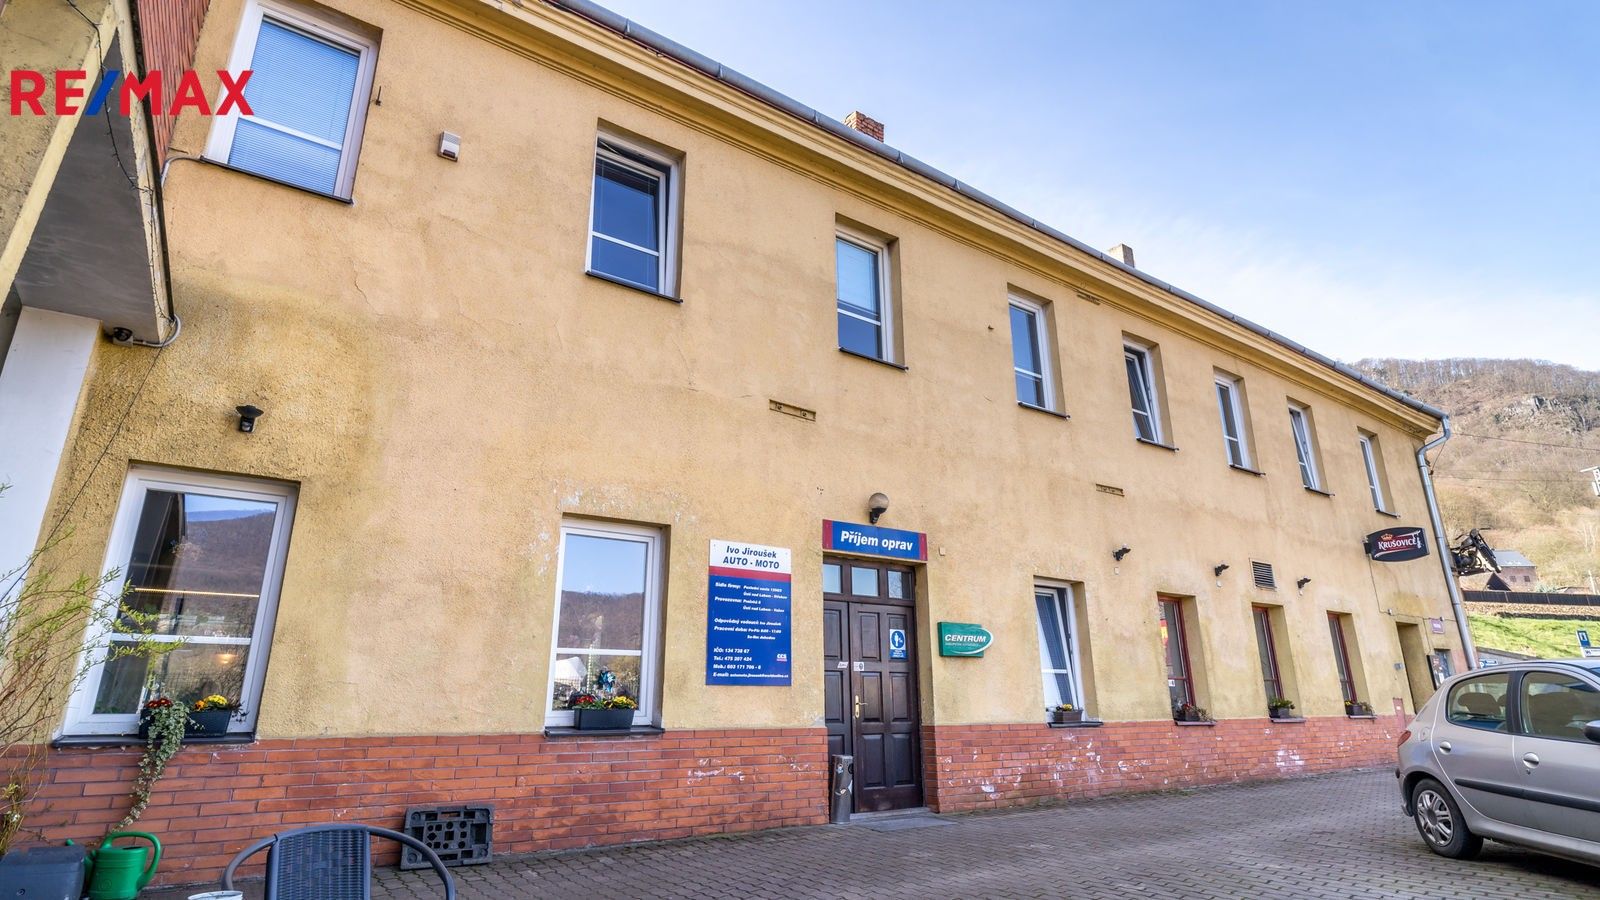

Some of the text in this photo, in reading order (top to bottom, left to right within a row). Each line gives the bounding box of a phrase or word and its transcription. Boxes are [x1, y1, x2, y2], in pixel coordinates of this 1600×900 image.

[841, 530, 913, 550] Příjem oprav
[1378, 538, 1417, 550] KRUŠOVICE
[726, 546, 777, 558] Ivo Jiroušek
[723, 556, 748, 565] AUTO
[755, 560, 779, 569] MOTO
[945, 634, 986, 642] CENTRUM
